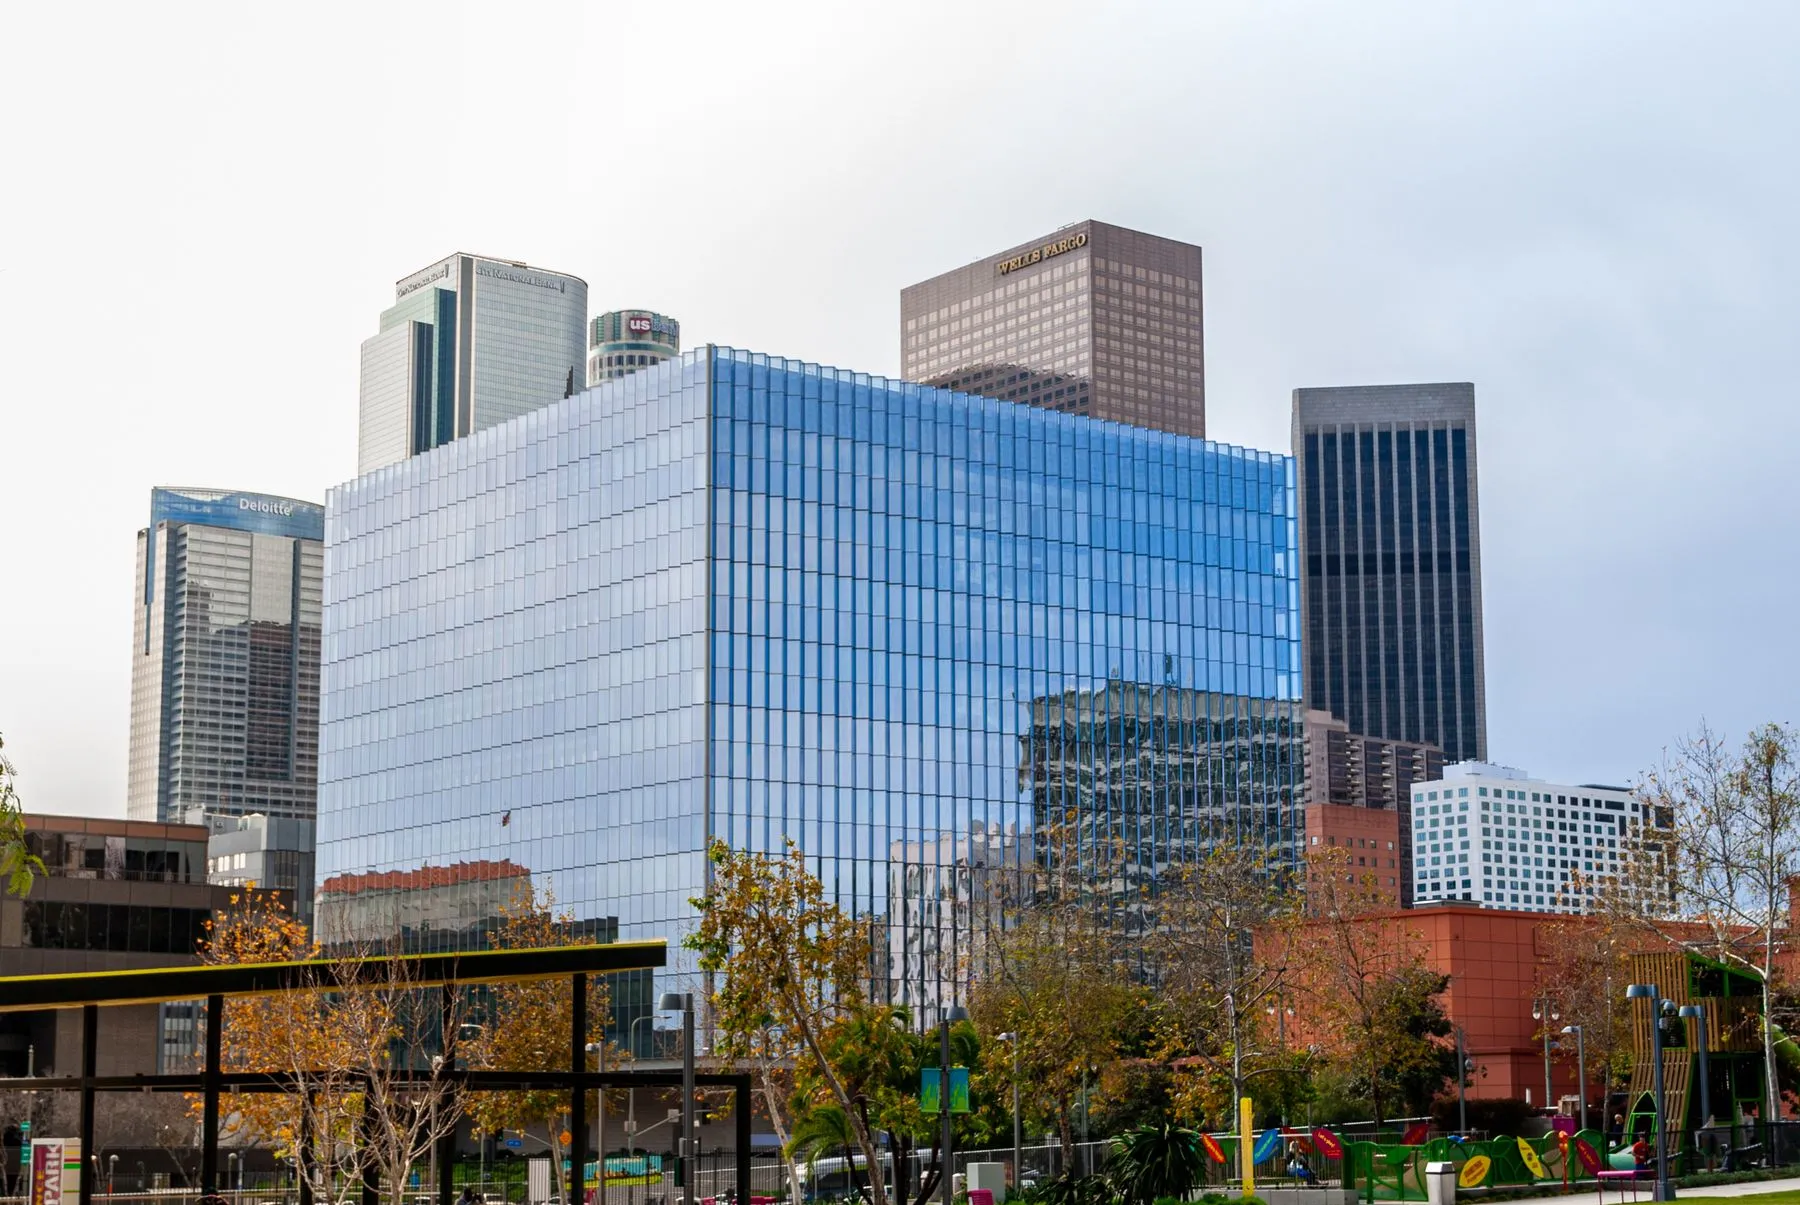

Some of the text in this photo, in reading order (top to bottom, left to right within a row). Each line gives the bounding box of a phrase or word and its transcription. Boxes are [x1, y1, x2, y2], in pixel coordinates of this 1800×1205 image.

[998, 233, 1087, 275] WELLS FARGO
[44, 1144, 62, 1205] PARK
